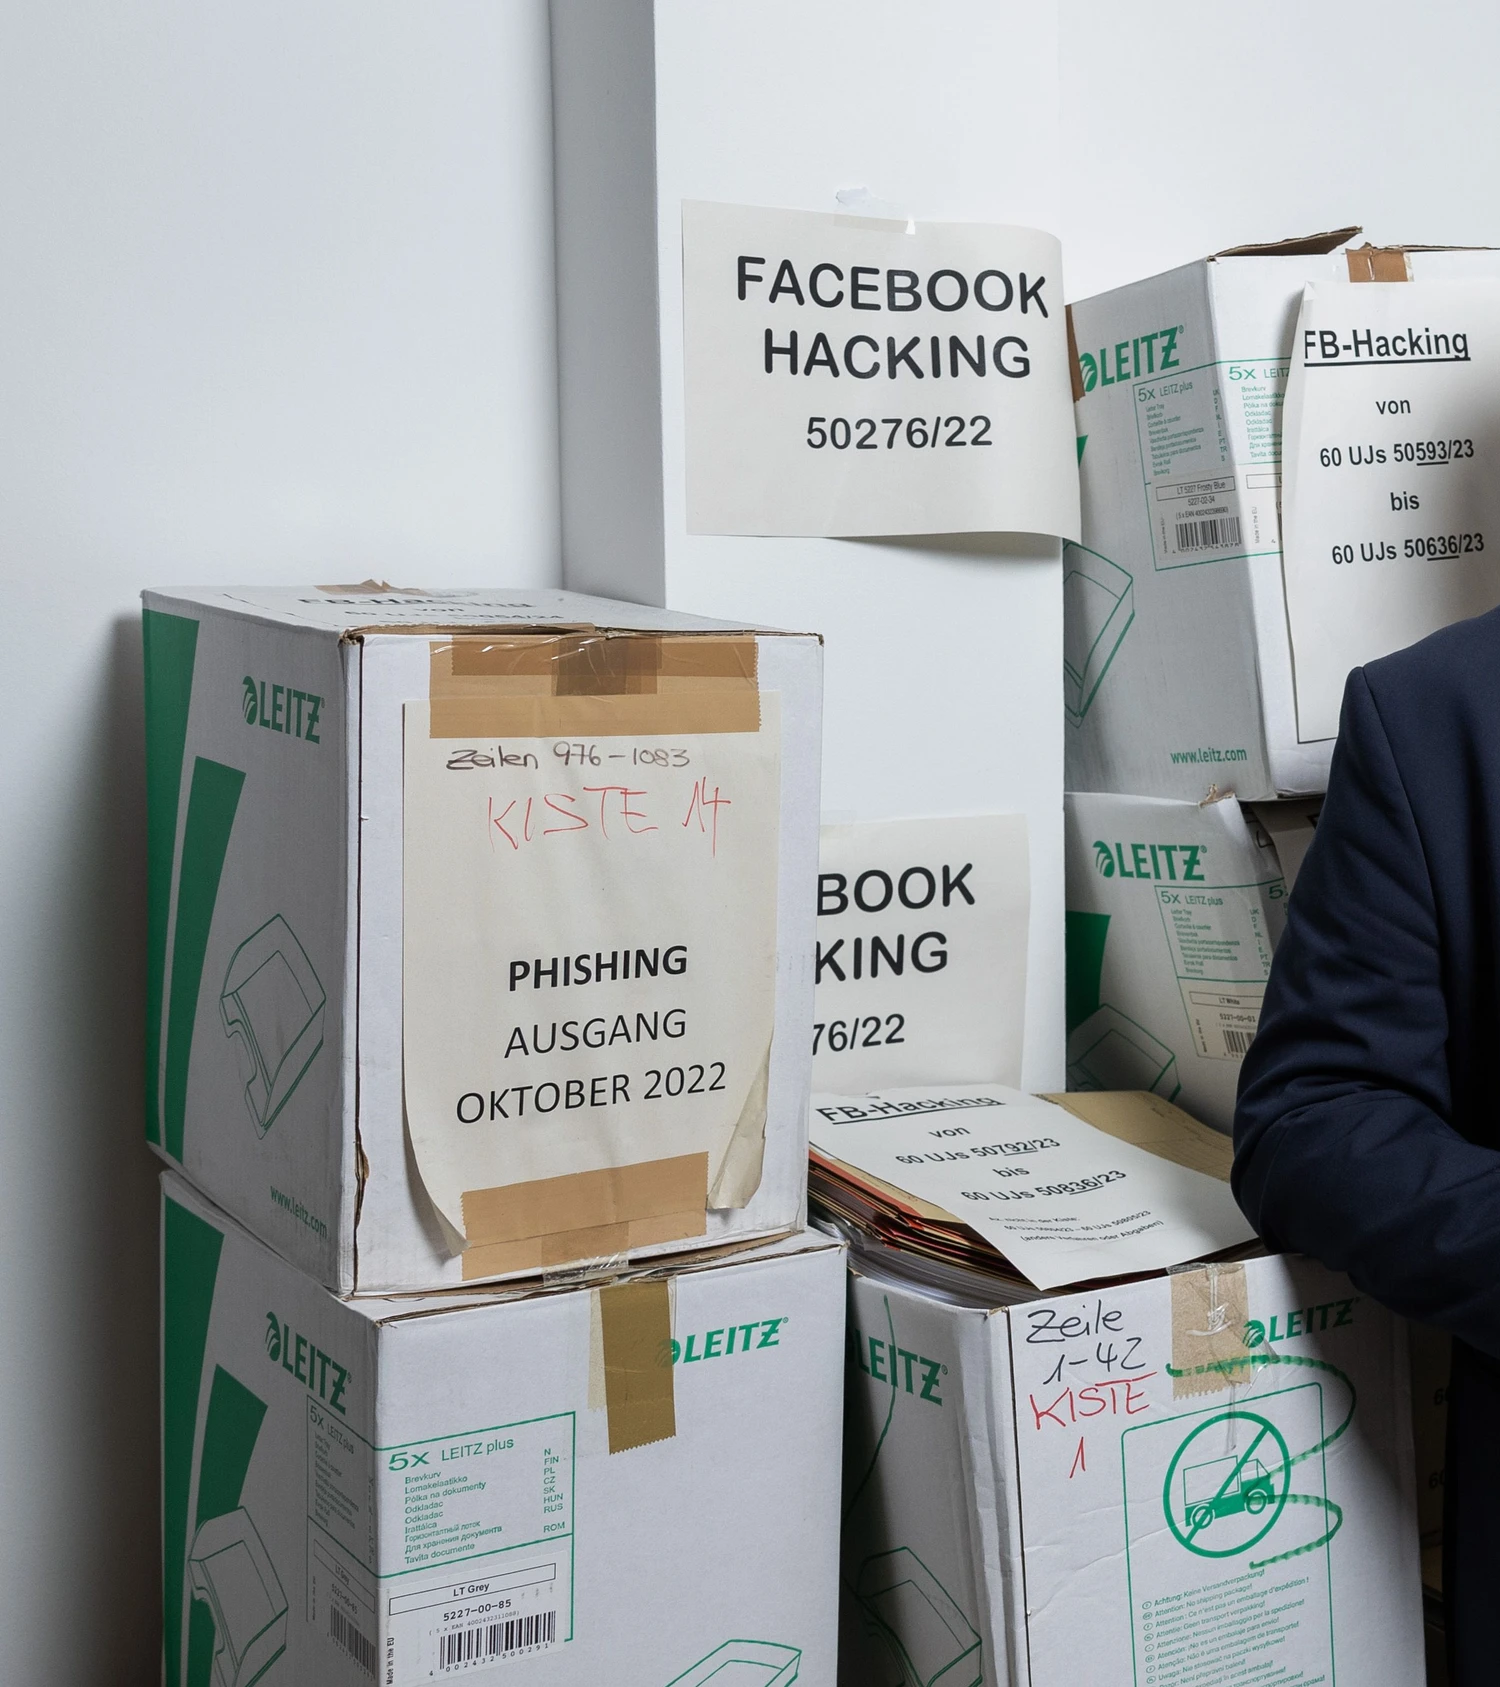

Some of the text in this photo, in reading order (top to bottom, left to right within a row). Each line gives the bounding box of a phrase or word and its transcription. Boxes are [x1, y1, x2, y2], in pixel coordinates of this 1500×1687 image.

[737, 255, 1049, 318] FACEBOOK
[764, 328, 1031, 379] HACKING
[1100, 326, 1180, 387] LEITZ
[1304, 328, 1470, 364] FB-Hacking
[1228, 366, 1257, 380] 5x
[1138, 381, 1194, 402] 5x LEITZ plus
[1376, 399, 1411, 414] von
[806, 415, 993, 451] 50276/22
[1320, 439, 1475, 467] 60 UJs 50593/23
[1214, 482, 1226, 490] Blue
[1390, 490, 1420, 511] bis
[1332, 532, 1485, 565] 60 UJs 50636/23
[259, 681, 322, 744] LEITZ
[446, 744, 538, 770] Zeilen
[1171, 748, 1247, 765] www.leitz.com
[488, 776, 731, 858] KISTE 14
[1115, 843, 1205, 882] LEITZ
[1161, 890, 1223, 906] 5x LEITZ plus
[509, 945, 688, 991] PHISHING
[504, 1008, 687, 1058] AUSGANG
[812, 1013, 905, 1055] 76/22
[456, 1061, 726, 1123] OKTOBER 2022
[815, 1095, 1002, 1122] FB-Hacking
[929, 1125, 970, 1139] von
[896, 1138, 1061, 1165] 60 UJs 50792/23
[961, 1170, 1127, 1201] 60 UJs 50836/23
[993, 1165, 1030, 1178] bis
[270, 1185, 328, 1239] www.leitz.com
[1027, 1299, 1122, 1343] Zeile
[1270, 1302, 1353, 1343] LEITZ
[683, 1318, 782, 1363] LEITZ
[282, 1323, 347, 1415] LEITZ
[1044, 1337, 1145, 1384] 1-42
[1031, 1372, 1156, 1429] KISTE
[388, 1438, 514, 1471] 5x LEITZ plus
[405, 1448, 551, 1484] Brevkurv N
[1069, 1437, 1085, 1478] 1
[405, 1456, 559, 1494] Lomakelaatikko FIN
[443, 1481, 486, 1496] dokumenty
[544, 1467, 556, 1475] PL
[543, 1476, 556, 1484] CZ
[543, 1486, 556, 1494] SK
[543, 1493, 563, 1504] HUN
[544, 1503, 563, 1513] RUS
[431, 1543, 475, 1558] documente
[543, 1522, 565, 1533] ROM
[453, 1583, 490, 1597] LT Grey
[1154, 1593, 1182, 1607] Achtung:
[1184, 1588, 1201, 1598] Keine
[1186, 1600, 1195, 1608] No
[1197, 1593, 1223, 1605] shipping
[443, 1599, 512, 1622] 5227-00-85
[451, 1622, 464, 1630] EAN
[387, 1637, 395, 1646] EU
[387, 1667, 395, 1685] Made
